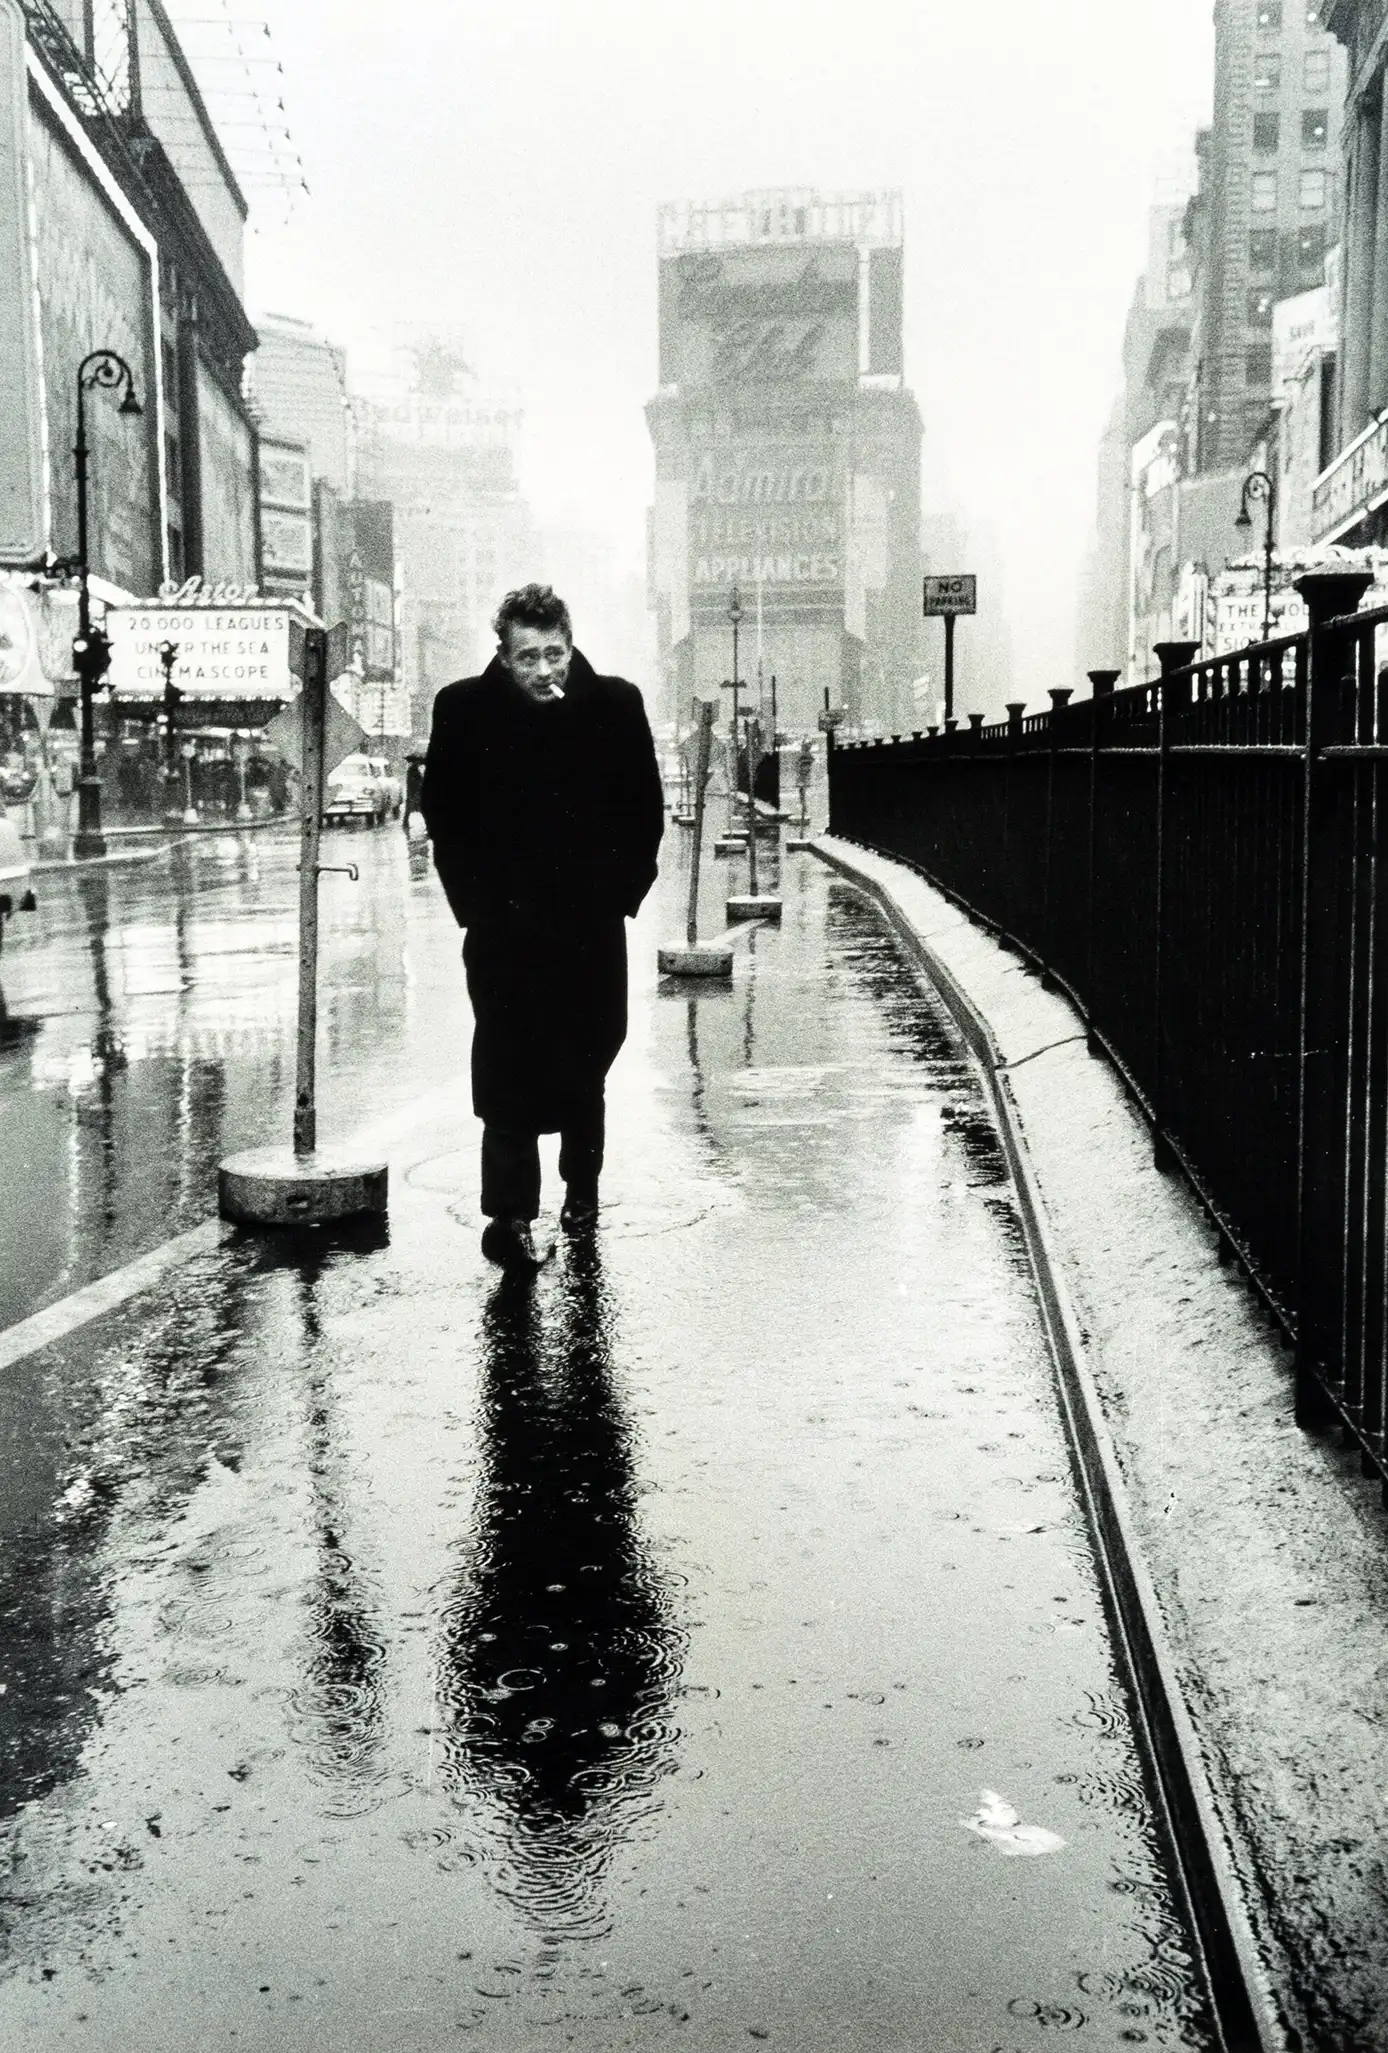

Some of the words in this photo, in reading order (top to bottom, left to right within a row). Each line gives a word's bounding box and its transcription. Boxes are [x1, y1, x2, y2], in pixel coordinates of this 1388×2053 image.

[694, 554, 840, 582] APPLIANCES
[159, 575, 260, 600] Astor
[938, 580, 963, 593] NO
[1226, 604, 1258, 618] THE
[205, 617, 284, 630] LEAGUES
[135, 642, 194, 654] UNER
[201, 642, 230, 654] THE
[238, 642, 270, 654] SEA
[137, 666, 269, 679] CINMASCOPE
